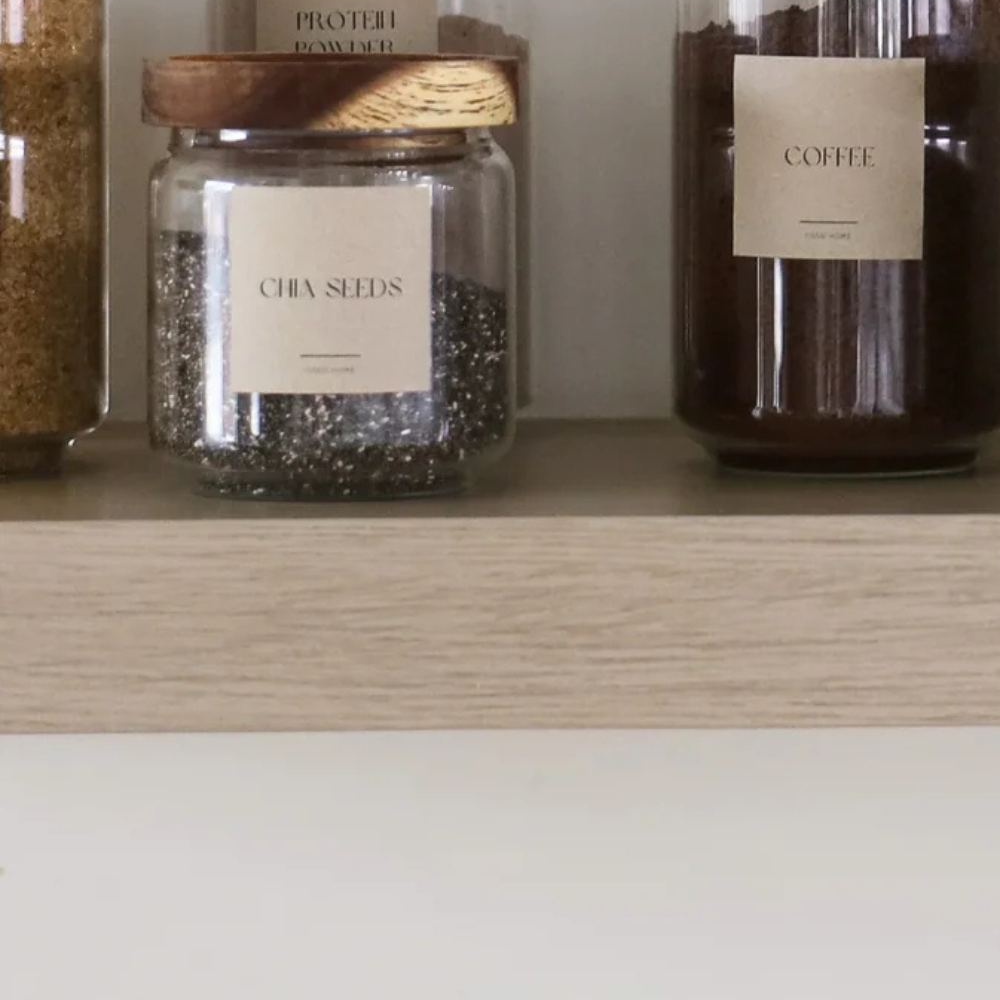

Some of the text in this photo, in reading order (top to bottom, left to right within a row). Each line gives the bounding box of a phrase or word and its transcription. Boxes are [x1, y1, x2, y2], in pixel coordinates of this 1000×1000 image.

[296, 9, 395, 31] PROTEIN
[784, 145, 876, 167] COFFEE
[260, 276, 404, 299] CHIA SEEDS
